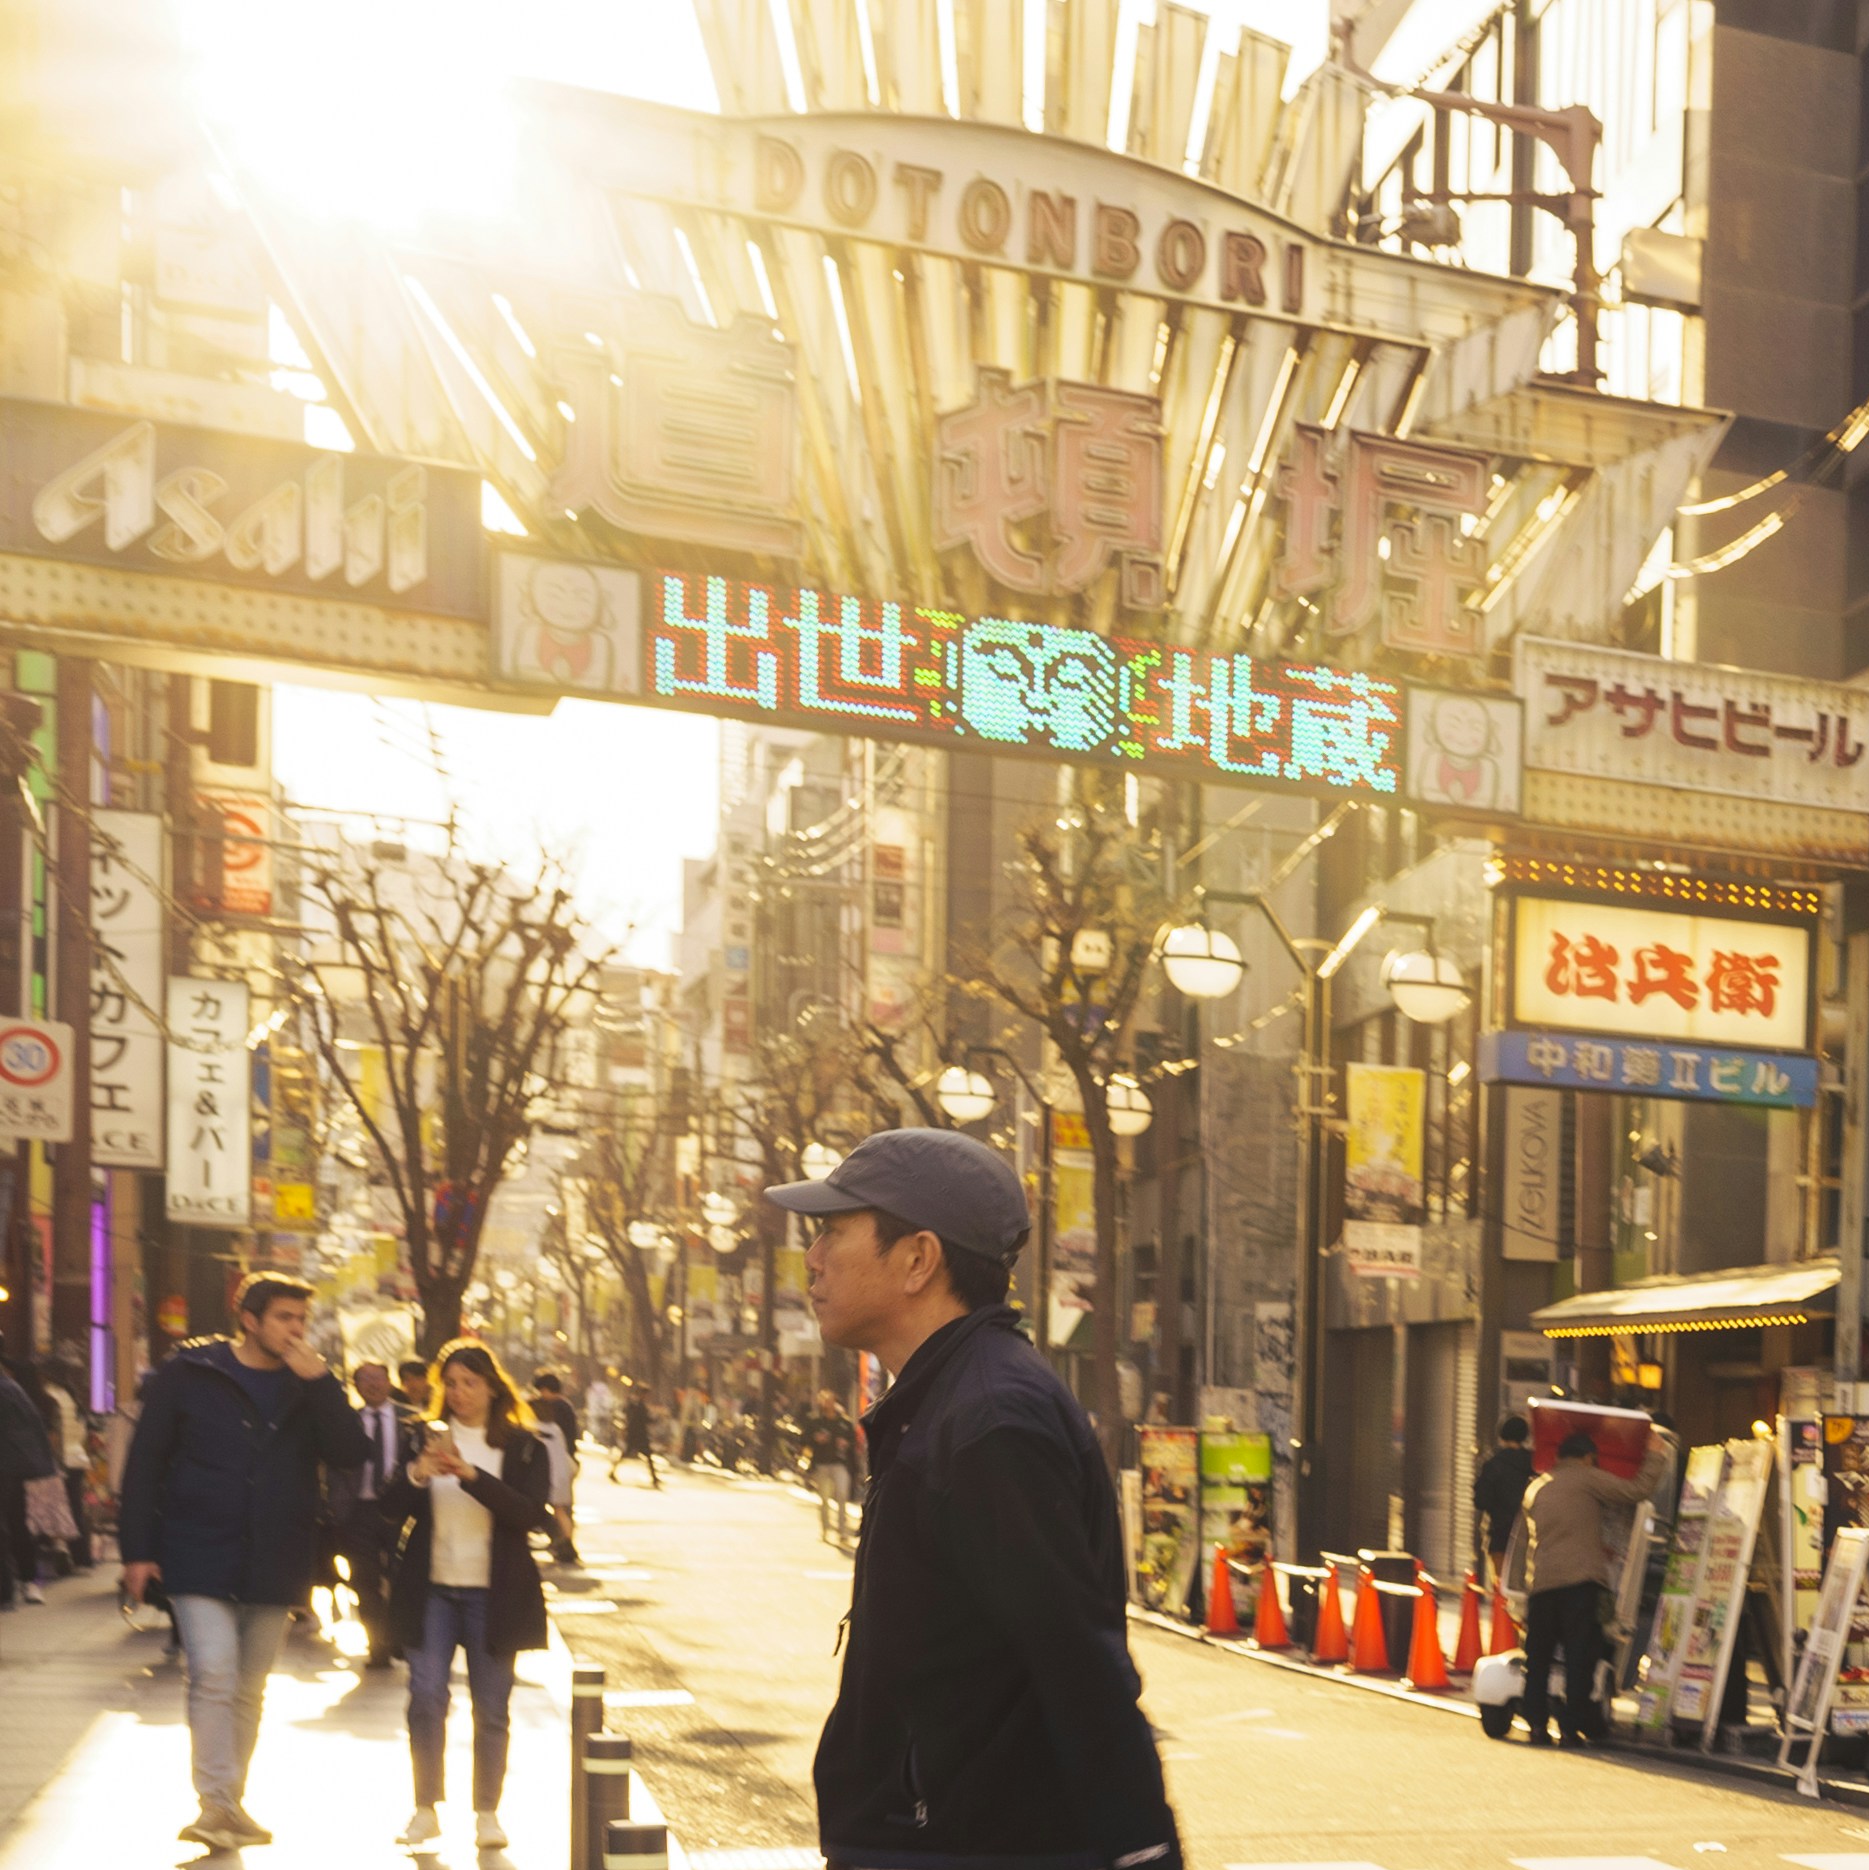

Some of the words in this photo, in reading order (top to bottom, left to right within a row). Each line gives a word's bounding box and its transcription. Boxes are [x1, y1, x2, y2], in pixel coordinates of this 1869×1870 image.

[752, 132, 1308, 316] DOTONBORI
[33, 418, 430, 594] Asahi
[546, 295, 1497, 658] 道頓堀
[655, 575, 917, 721] 出世
[1155, 650, 1398, 794] 地蔵
[1545, 672, 1865, 769] アサヒビール
[4, 1039, 46, 1073] 30
[1545, 929, 1783, 1019] 治兵衛
